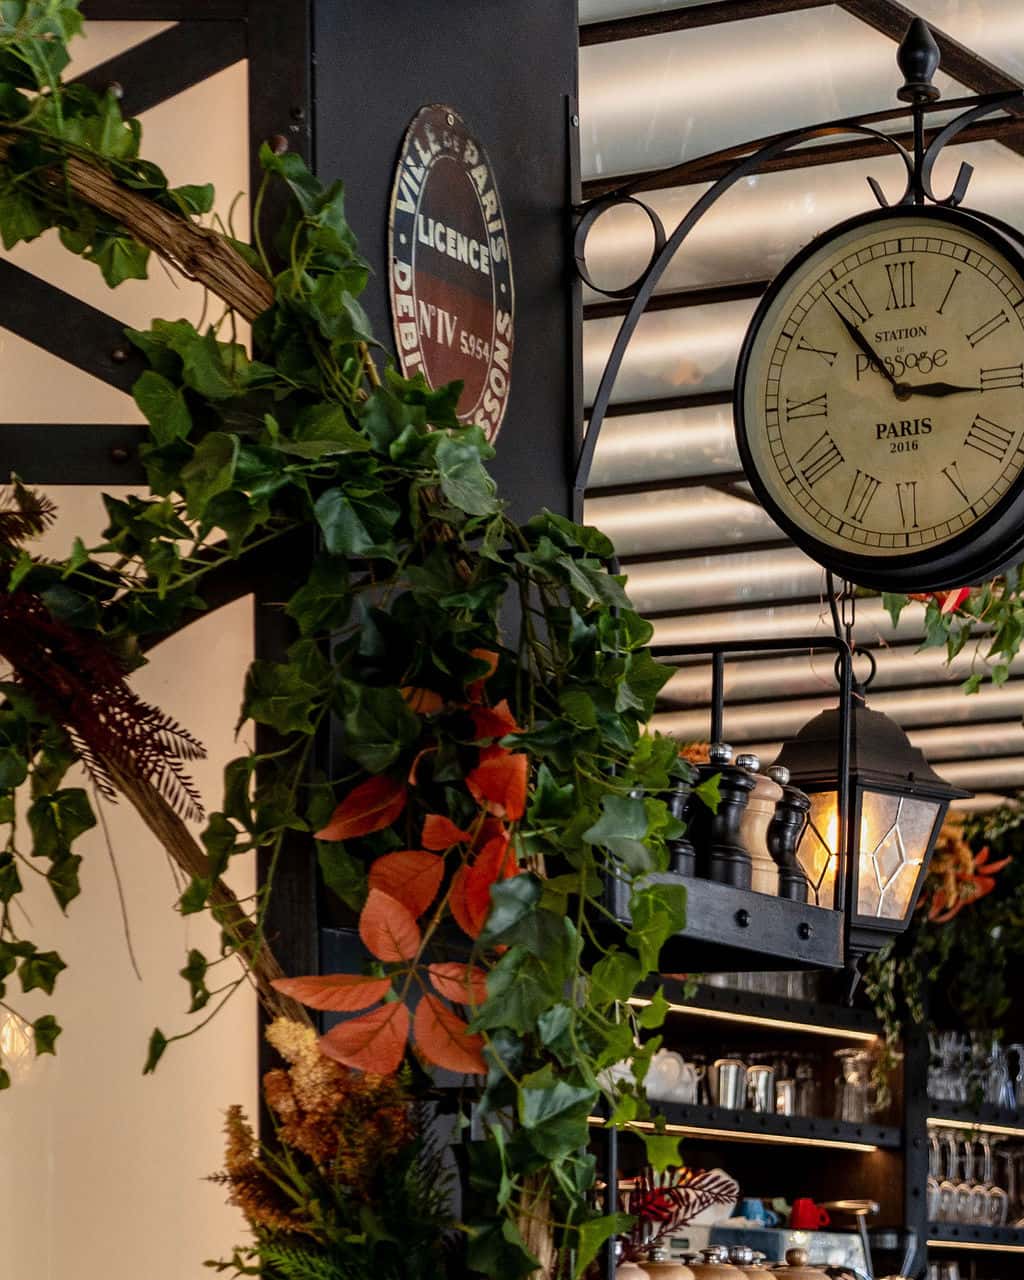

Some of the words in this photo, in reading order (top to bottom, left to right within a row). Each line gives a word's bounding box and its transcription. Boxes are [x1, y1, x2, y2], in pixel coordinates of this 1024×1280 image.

[396, 122, 442, 214] VILLE
[463, 139, 507, 262] PARIS
[418, 214, 489, 275] LICENCE
[835, 280, 874, 329] XI
[885, 261, 915, 311] XII
[936, 268, 961, 315] I
[796, 336, 837, 367] X
[875, 326, 928, 343] STATION
[965, 308, 1010, 349] II
[980, 363, 1024, 393] III
[786, 392, 827, 423] IX
[875, 417, 933, 440] PARIS
[797, 430, 845, 488] VIII
[889, 440, 919, 453] 2016
[843, 469, 882, 523] VII
[896, 481, 919, 528] VI
